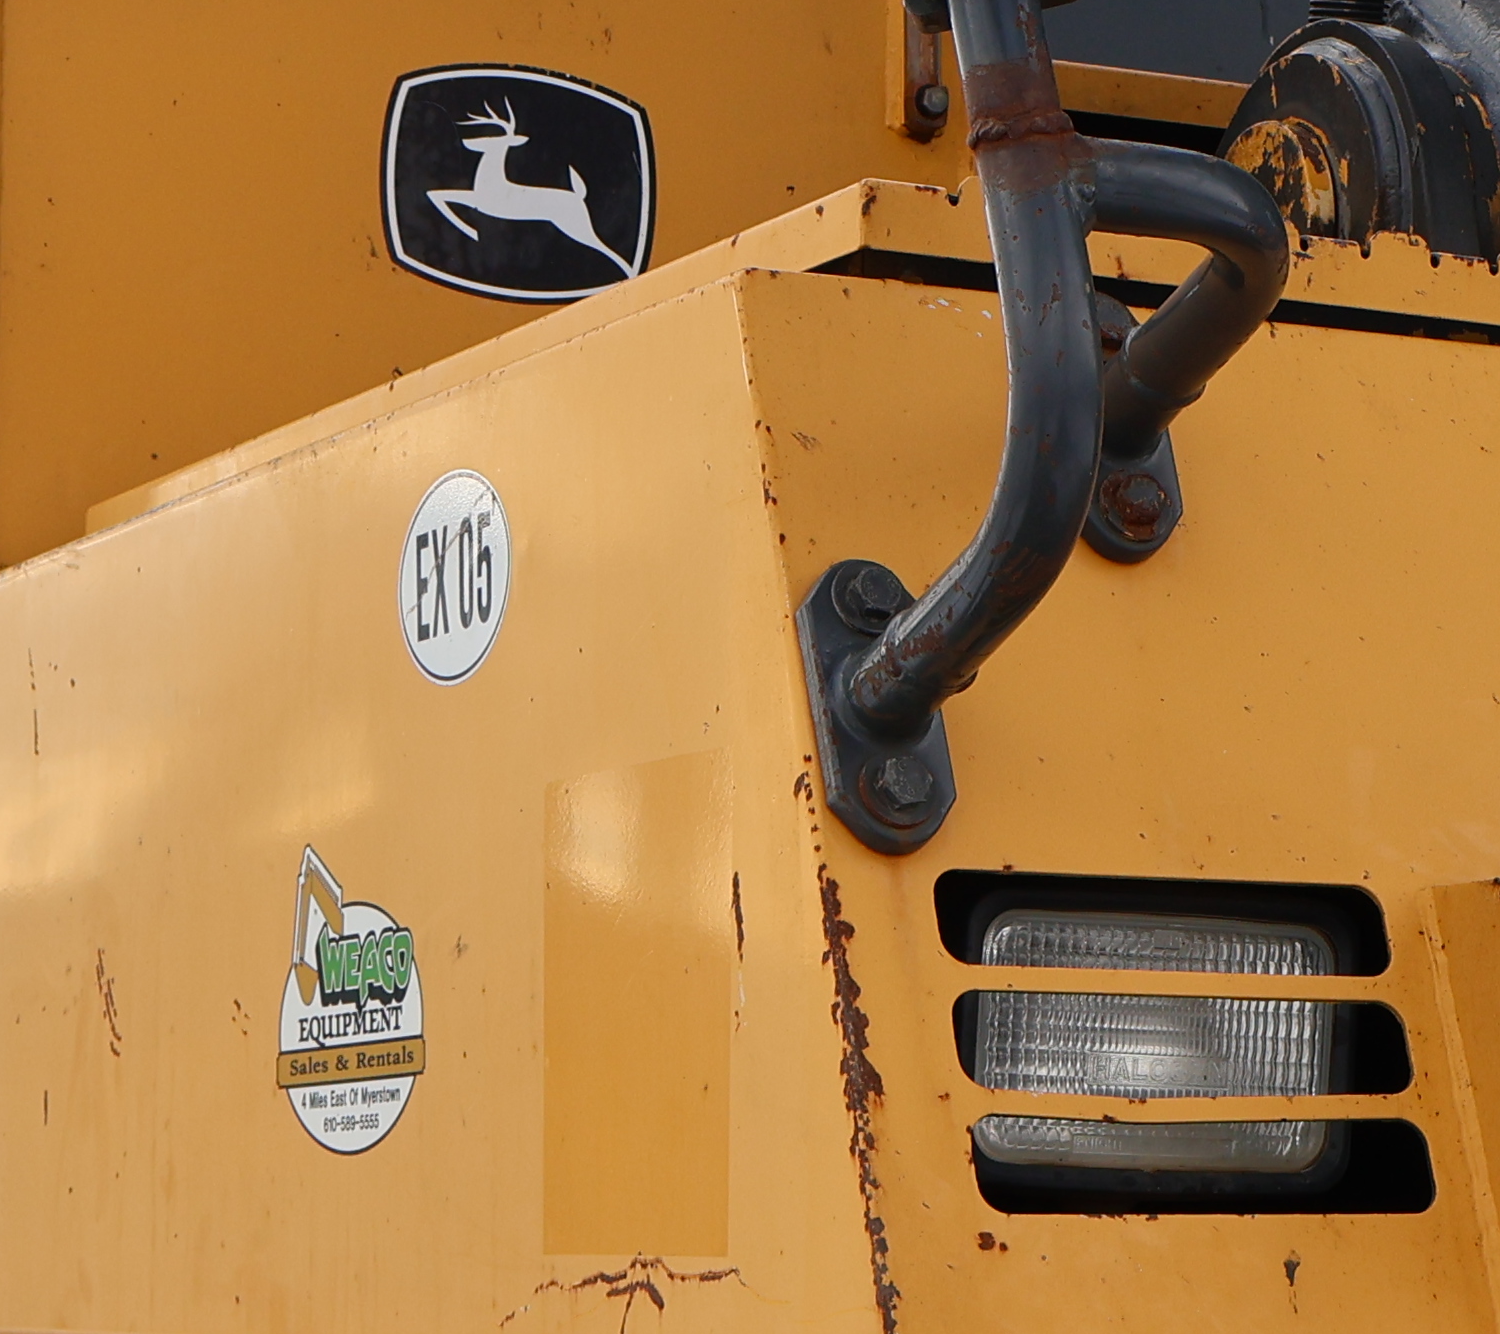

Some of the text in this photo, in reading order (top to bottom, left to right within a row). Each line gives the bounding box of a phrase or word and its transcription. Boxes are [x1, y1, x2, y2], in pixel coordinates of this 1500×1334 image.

[415, 511, 492, 643] EX 05
[316, 923, 414, 1009] WEACO
[298, 1005, 404, 1047] EQUIPMENT
[289, 1045, 415, 1077] Sales & Rentals
[301, 1086, 401, 1109] 4 Miles East Of Myerstown
[323, 1112, 380, 1134] 610-589-5555
